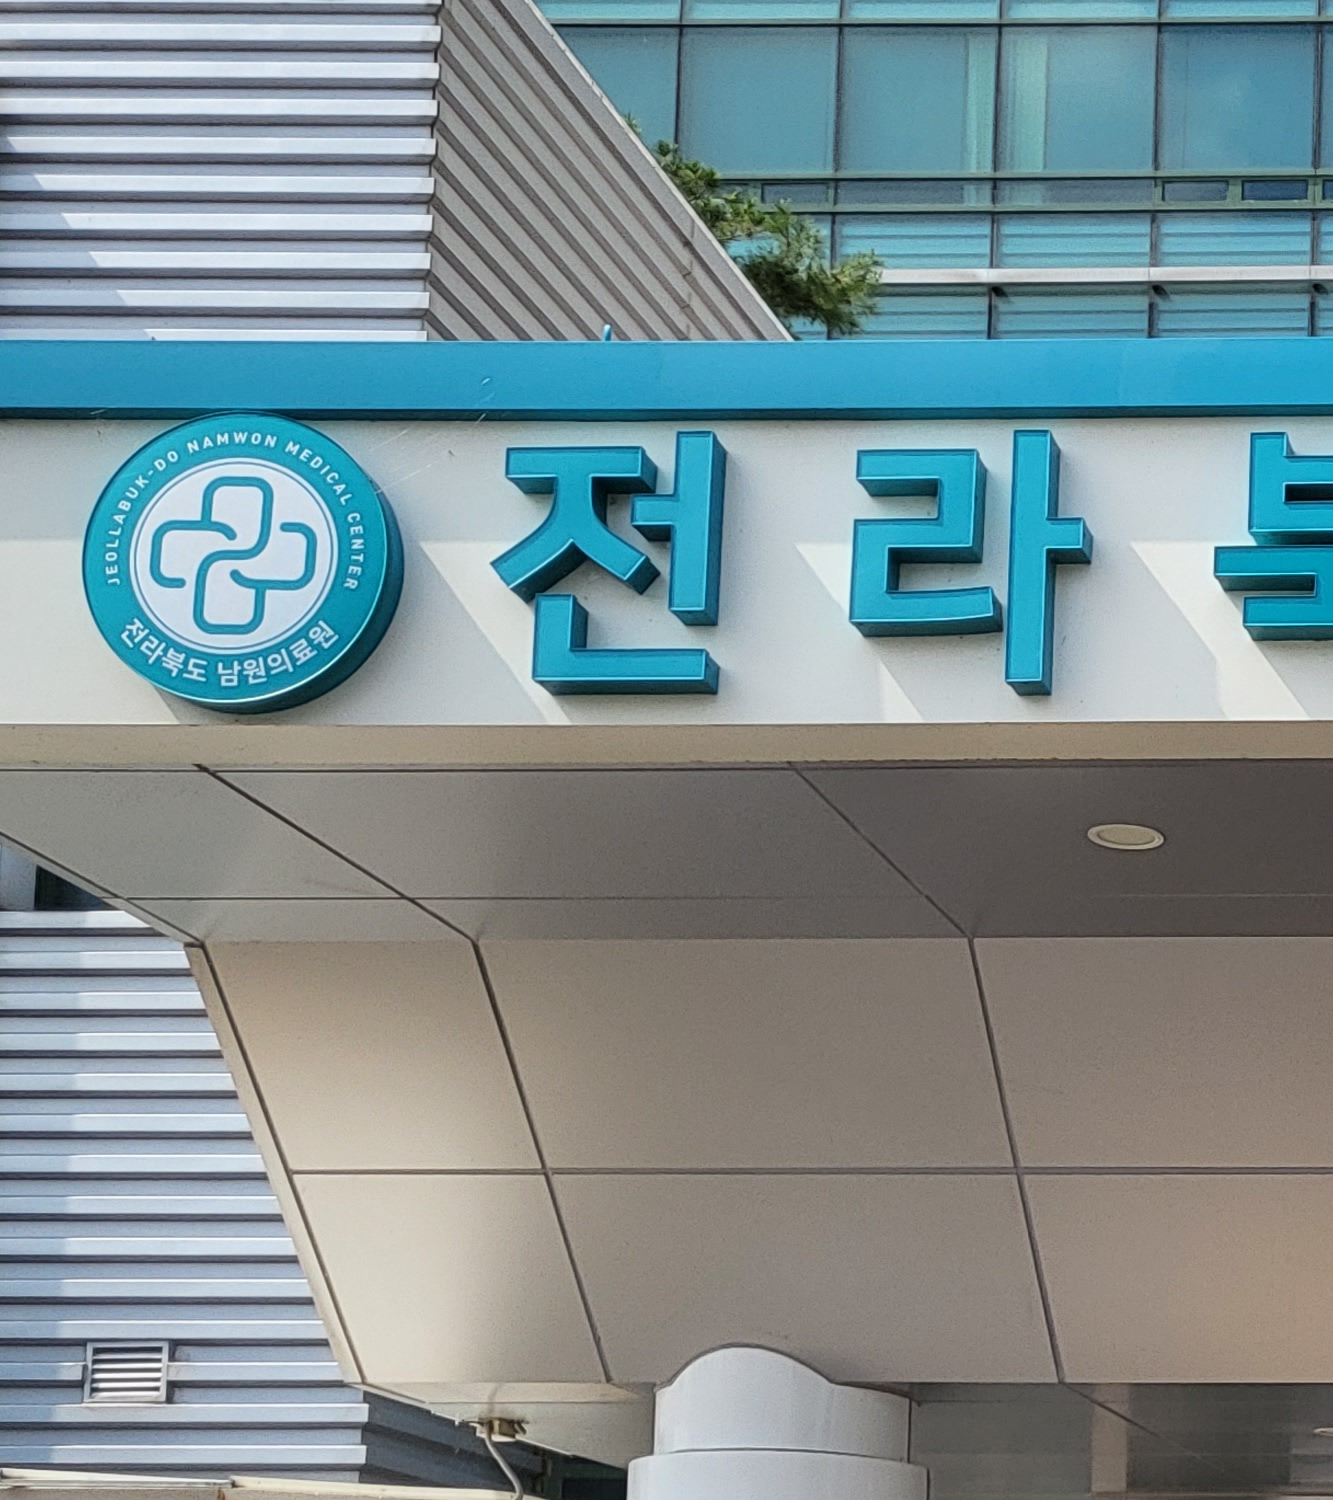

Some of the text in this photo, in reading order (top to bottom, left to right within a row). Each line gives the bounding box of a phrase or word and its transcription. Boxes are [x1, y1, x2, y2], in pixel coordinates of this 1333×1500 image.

[105, 431, 366, 591] JEOLLABUK-DO NAMWON MEDICAL CENTER
[120, 617, 339, 687] 전라북도 남원의료원
